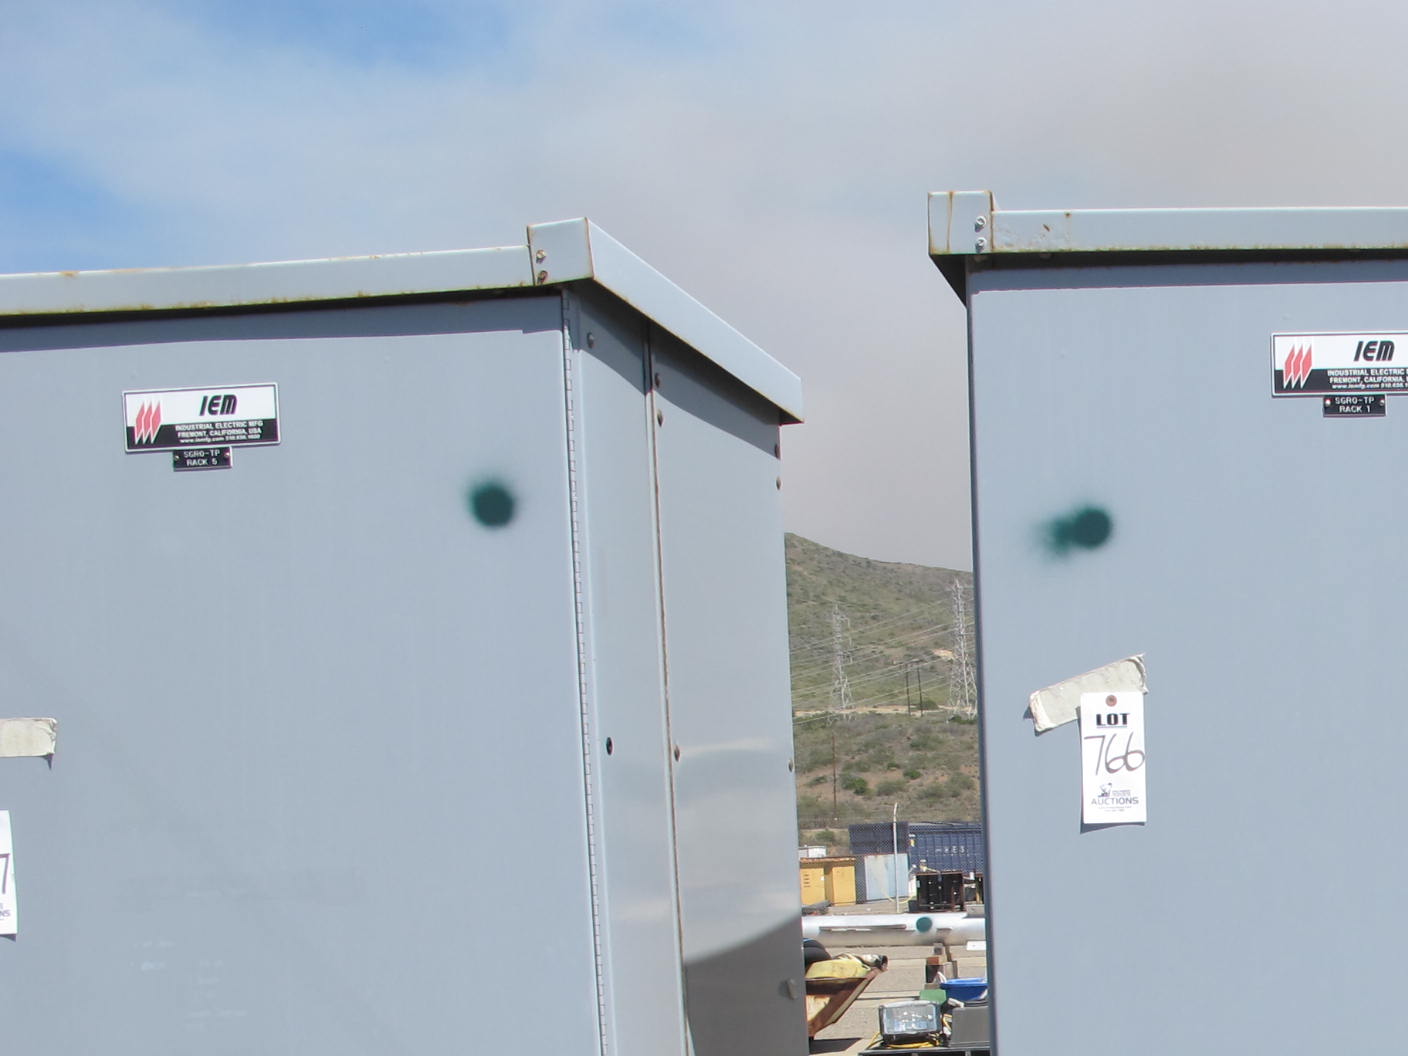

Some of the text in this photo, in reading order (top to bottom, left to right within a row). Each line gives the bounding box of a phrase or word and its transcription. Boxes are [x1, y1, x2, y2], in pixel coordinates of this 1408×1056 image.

[1354, 340, 1395, 362] IEM
[1370, 368, 1404, 376] ELECTRIC
[199, 394, 238, 416] IEM
[1339, 405, 1372, 413] RACK 1
[175, 423, 214, 431] INDUSTRIAL
[215, 421, 248, 429] ELECTRIC
[1096, 712, 1131, 726] LOT
[1084, 731, 1145, 776] 766
[1090, 796, 1140, 806] AUCTIONS
